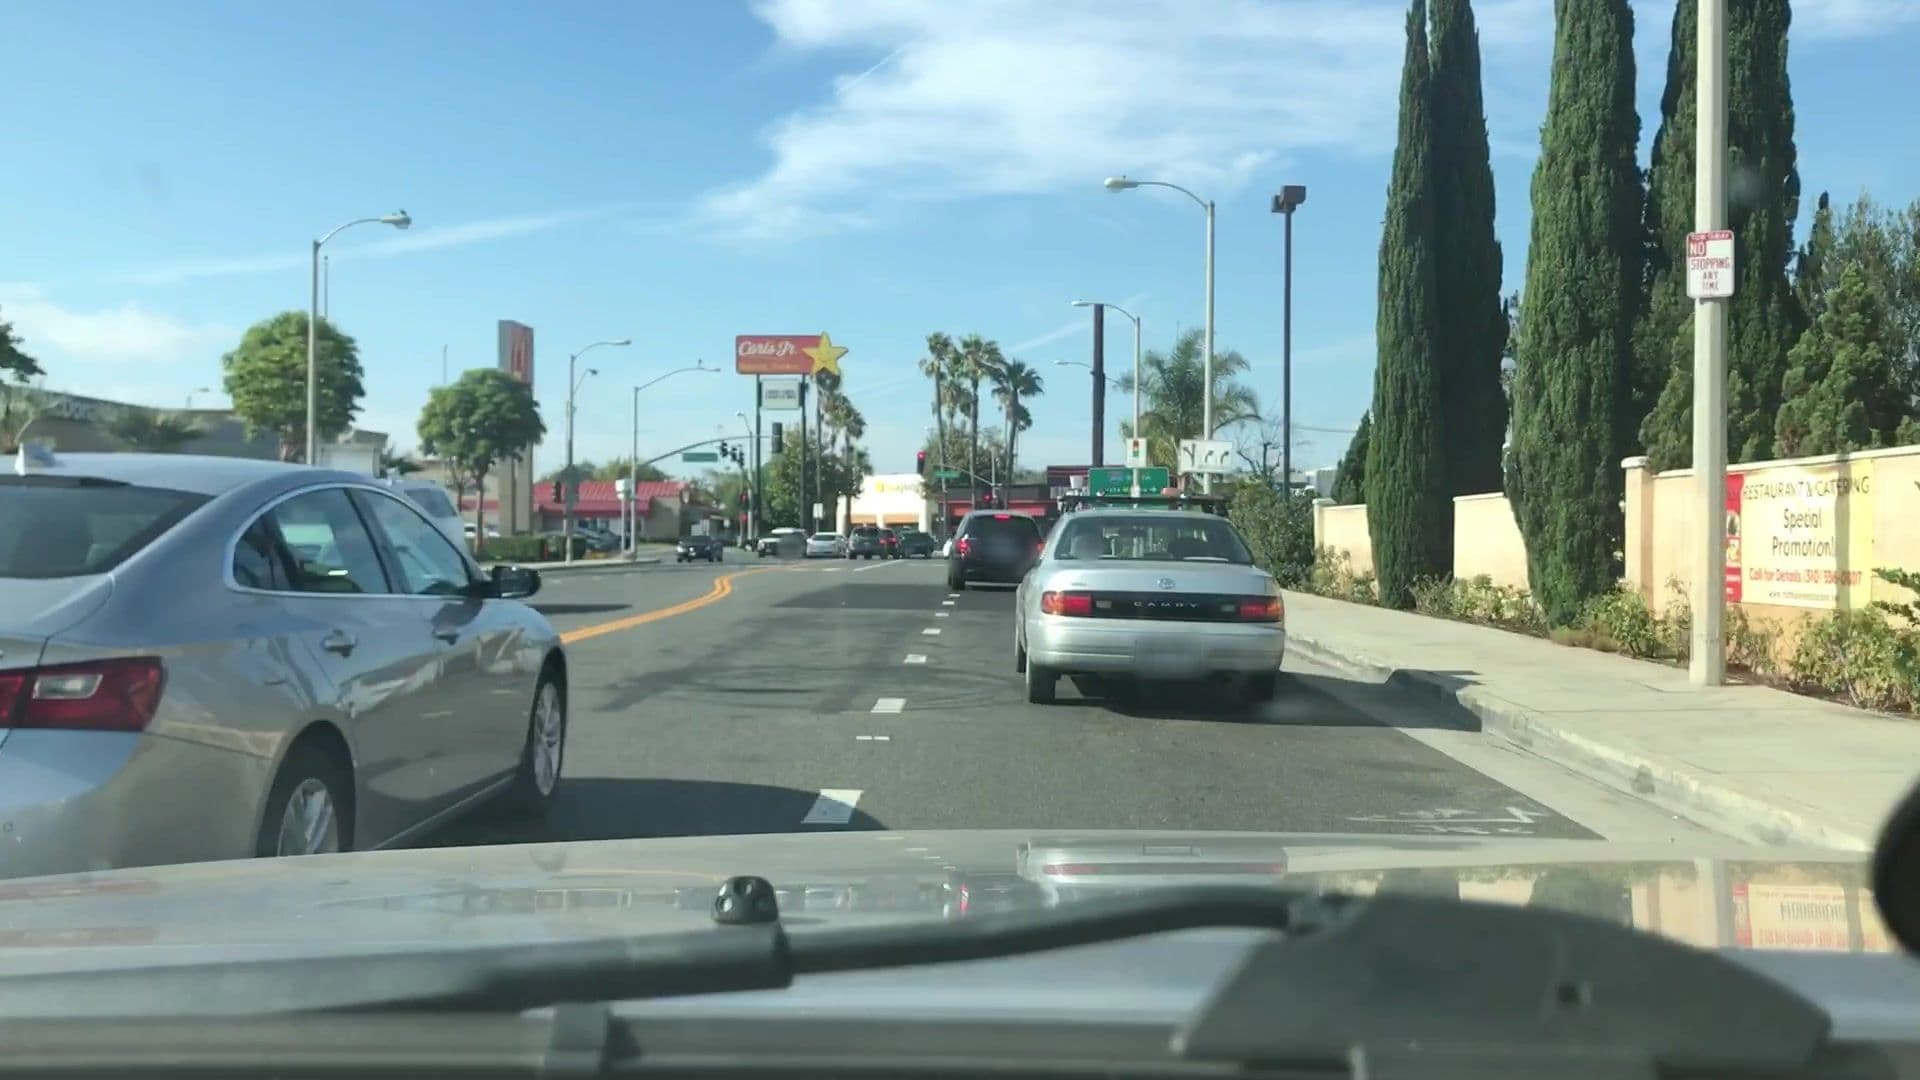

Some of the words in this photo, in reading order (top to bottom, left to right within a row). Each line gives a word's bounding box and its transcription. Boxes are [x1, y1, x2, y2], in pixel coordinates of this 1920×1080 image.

[1690, 240, 1705, 256] NO
[1691, 257, 1730, 270] STOPPING
[1703, 271, 1719, 280] ANY
[1703, 281, 1720, 290] TIME
[1744, 480, 1804, 500] RESTAURANT
[1815, 476, 1870, 497] CATERING
[1783, 507, 1822, 534] Special
[1772, 535, 1834, 557] Promotion!
